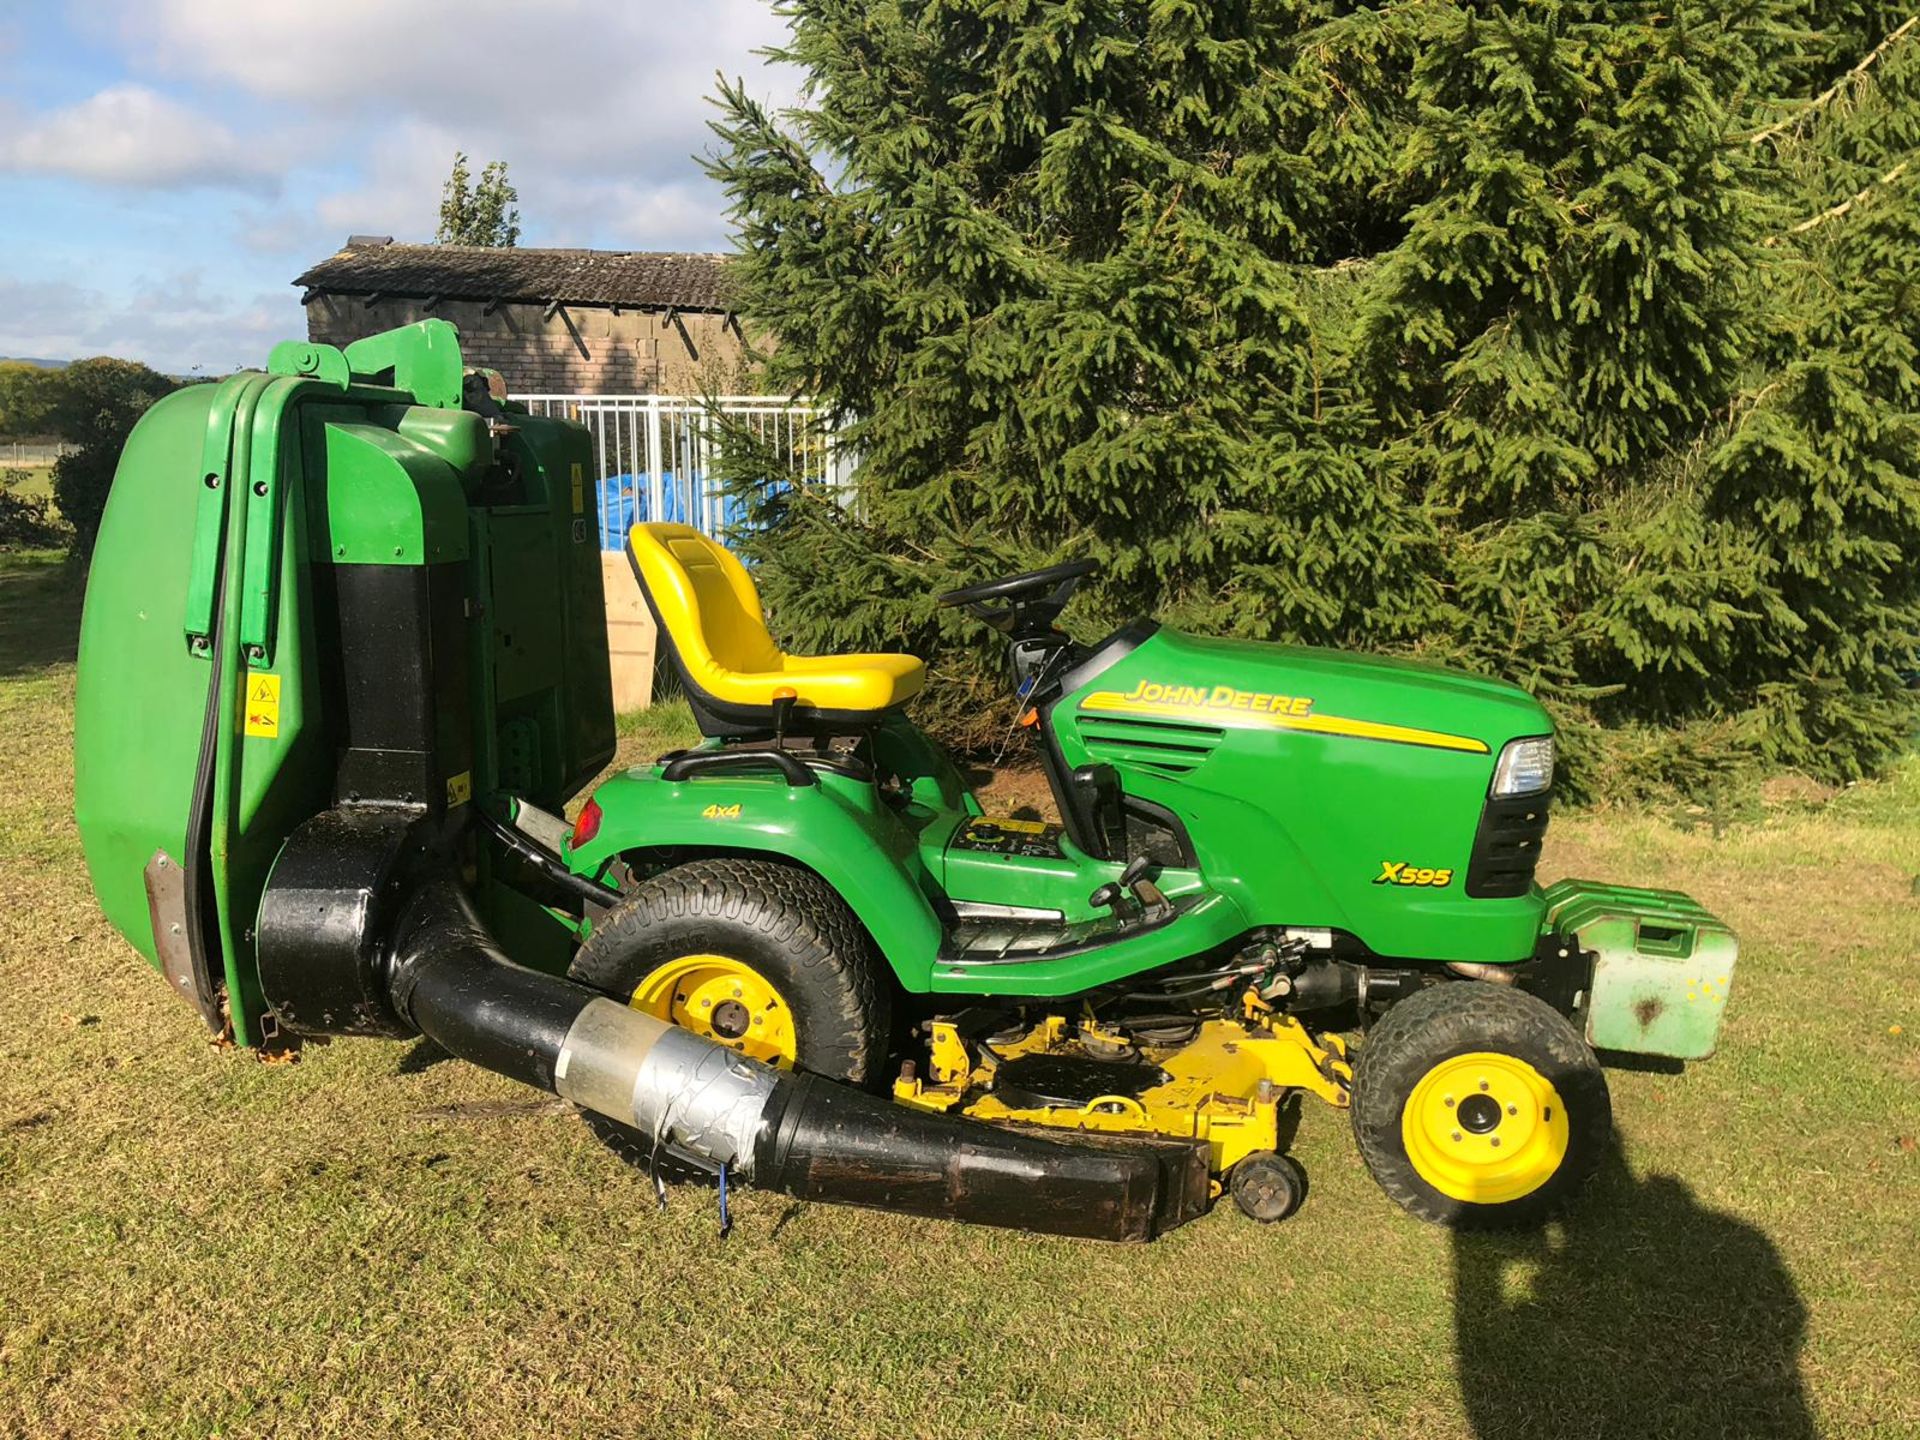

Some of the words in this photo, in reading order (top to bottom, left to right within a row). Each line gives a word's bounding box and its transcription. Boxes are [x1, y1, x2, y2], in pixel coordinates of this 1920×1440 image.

[1125, 680, 1206, 707] JOHN
[1209, 686, 1314, 716] DEERE
[702, 803, 742, 818] 4x4
[1373, 861, 1452, 887] X595
